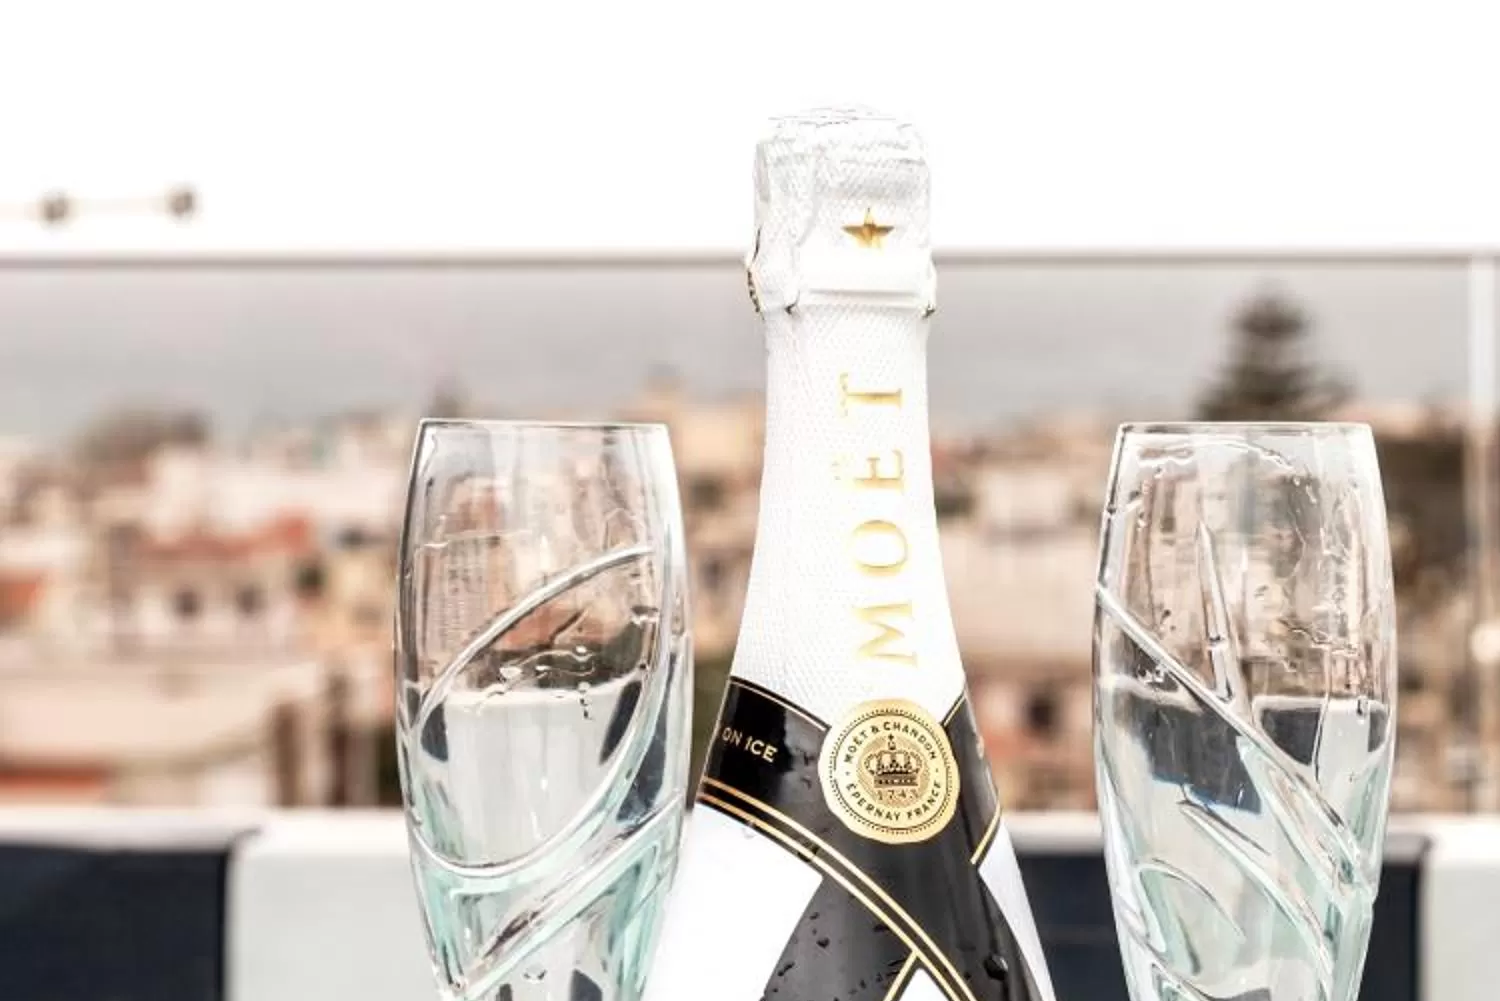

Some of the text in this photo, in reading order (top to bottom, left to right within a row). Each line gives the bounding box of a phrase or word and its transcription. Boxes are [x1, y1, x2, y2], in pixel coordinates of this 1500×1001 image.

[721, 726, 779, 763] ON ICE
[883, 721, 937, 761] CHANDON
[906, 779, 941, 819] FRANCE
